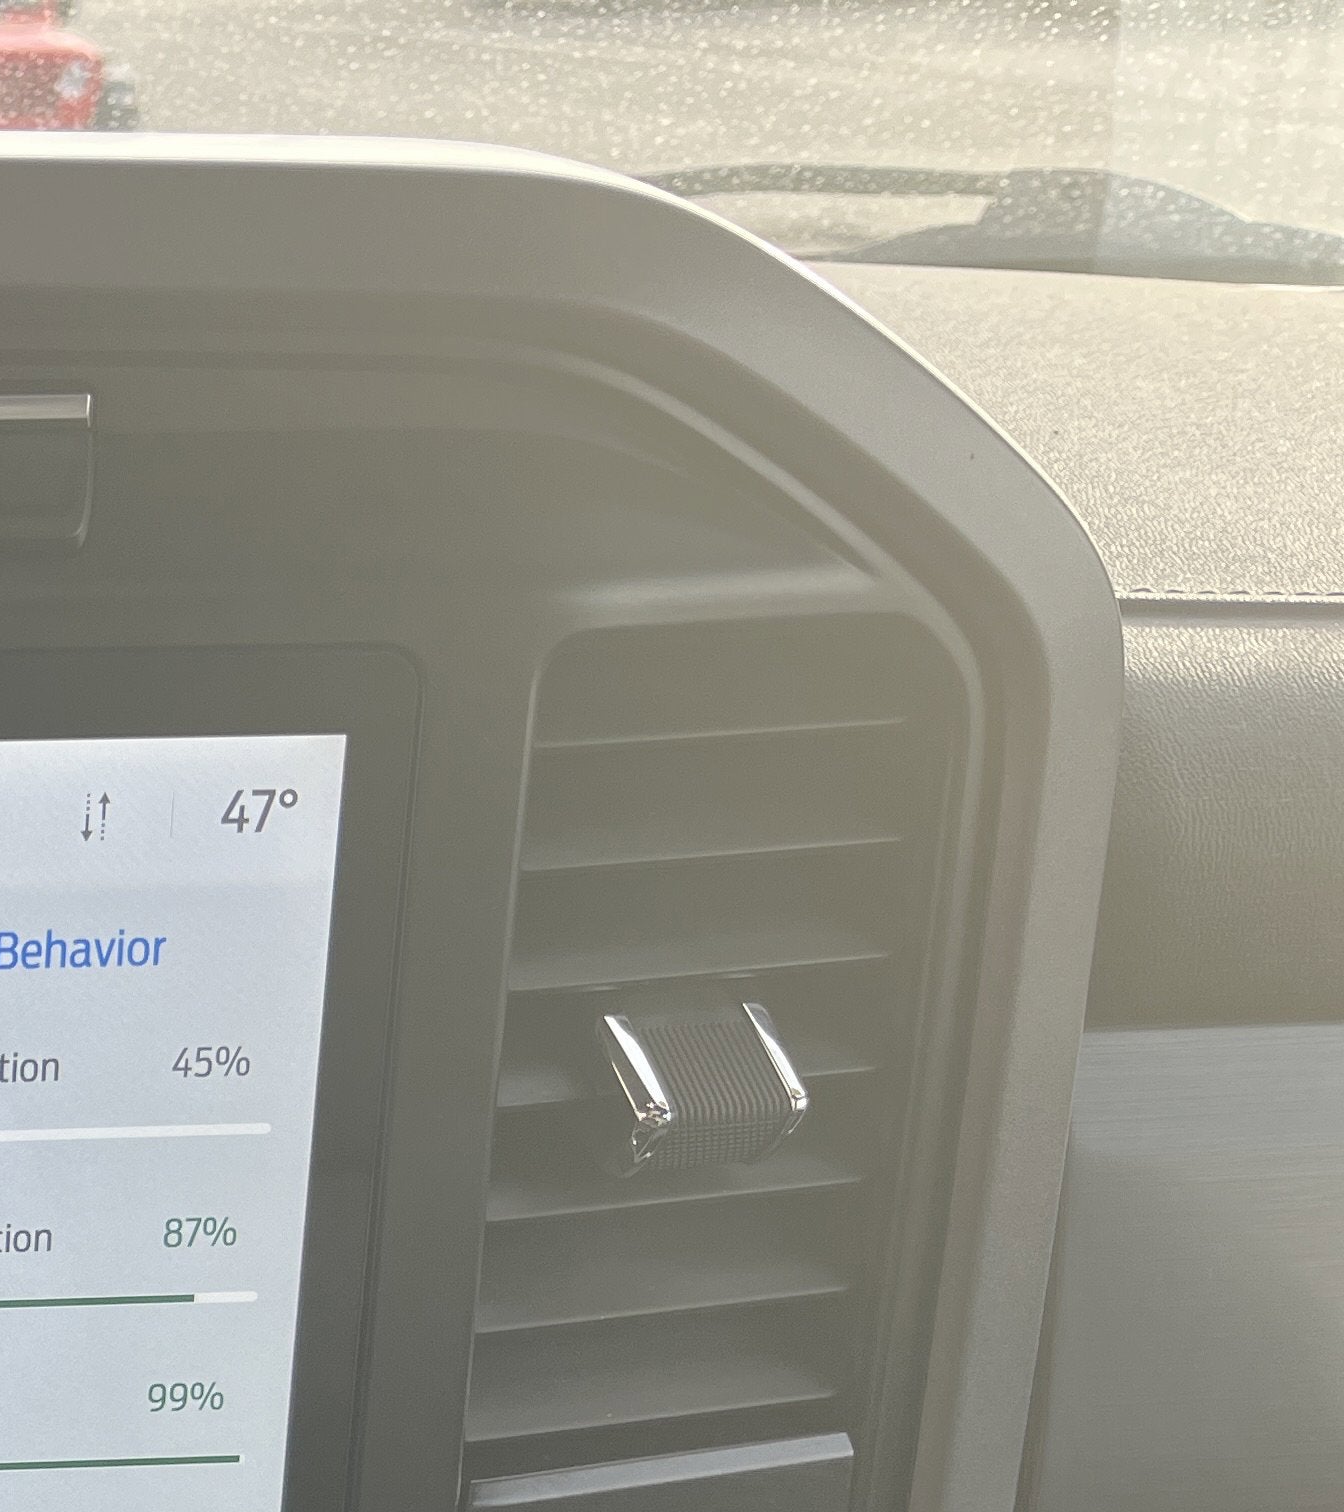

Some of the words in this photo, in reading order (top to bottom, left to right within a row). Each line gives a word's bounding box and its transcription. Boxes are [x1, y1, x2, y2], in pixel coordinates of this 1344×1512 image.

[220, 788, 299, 834] 47°
[171, 1045, 251, 1078] 45%
[163, 1216, 237, 1248] 87%
[148, 1381, 224, 1413] 99%
